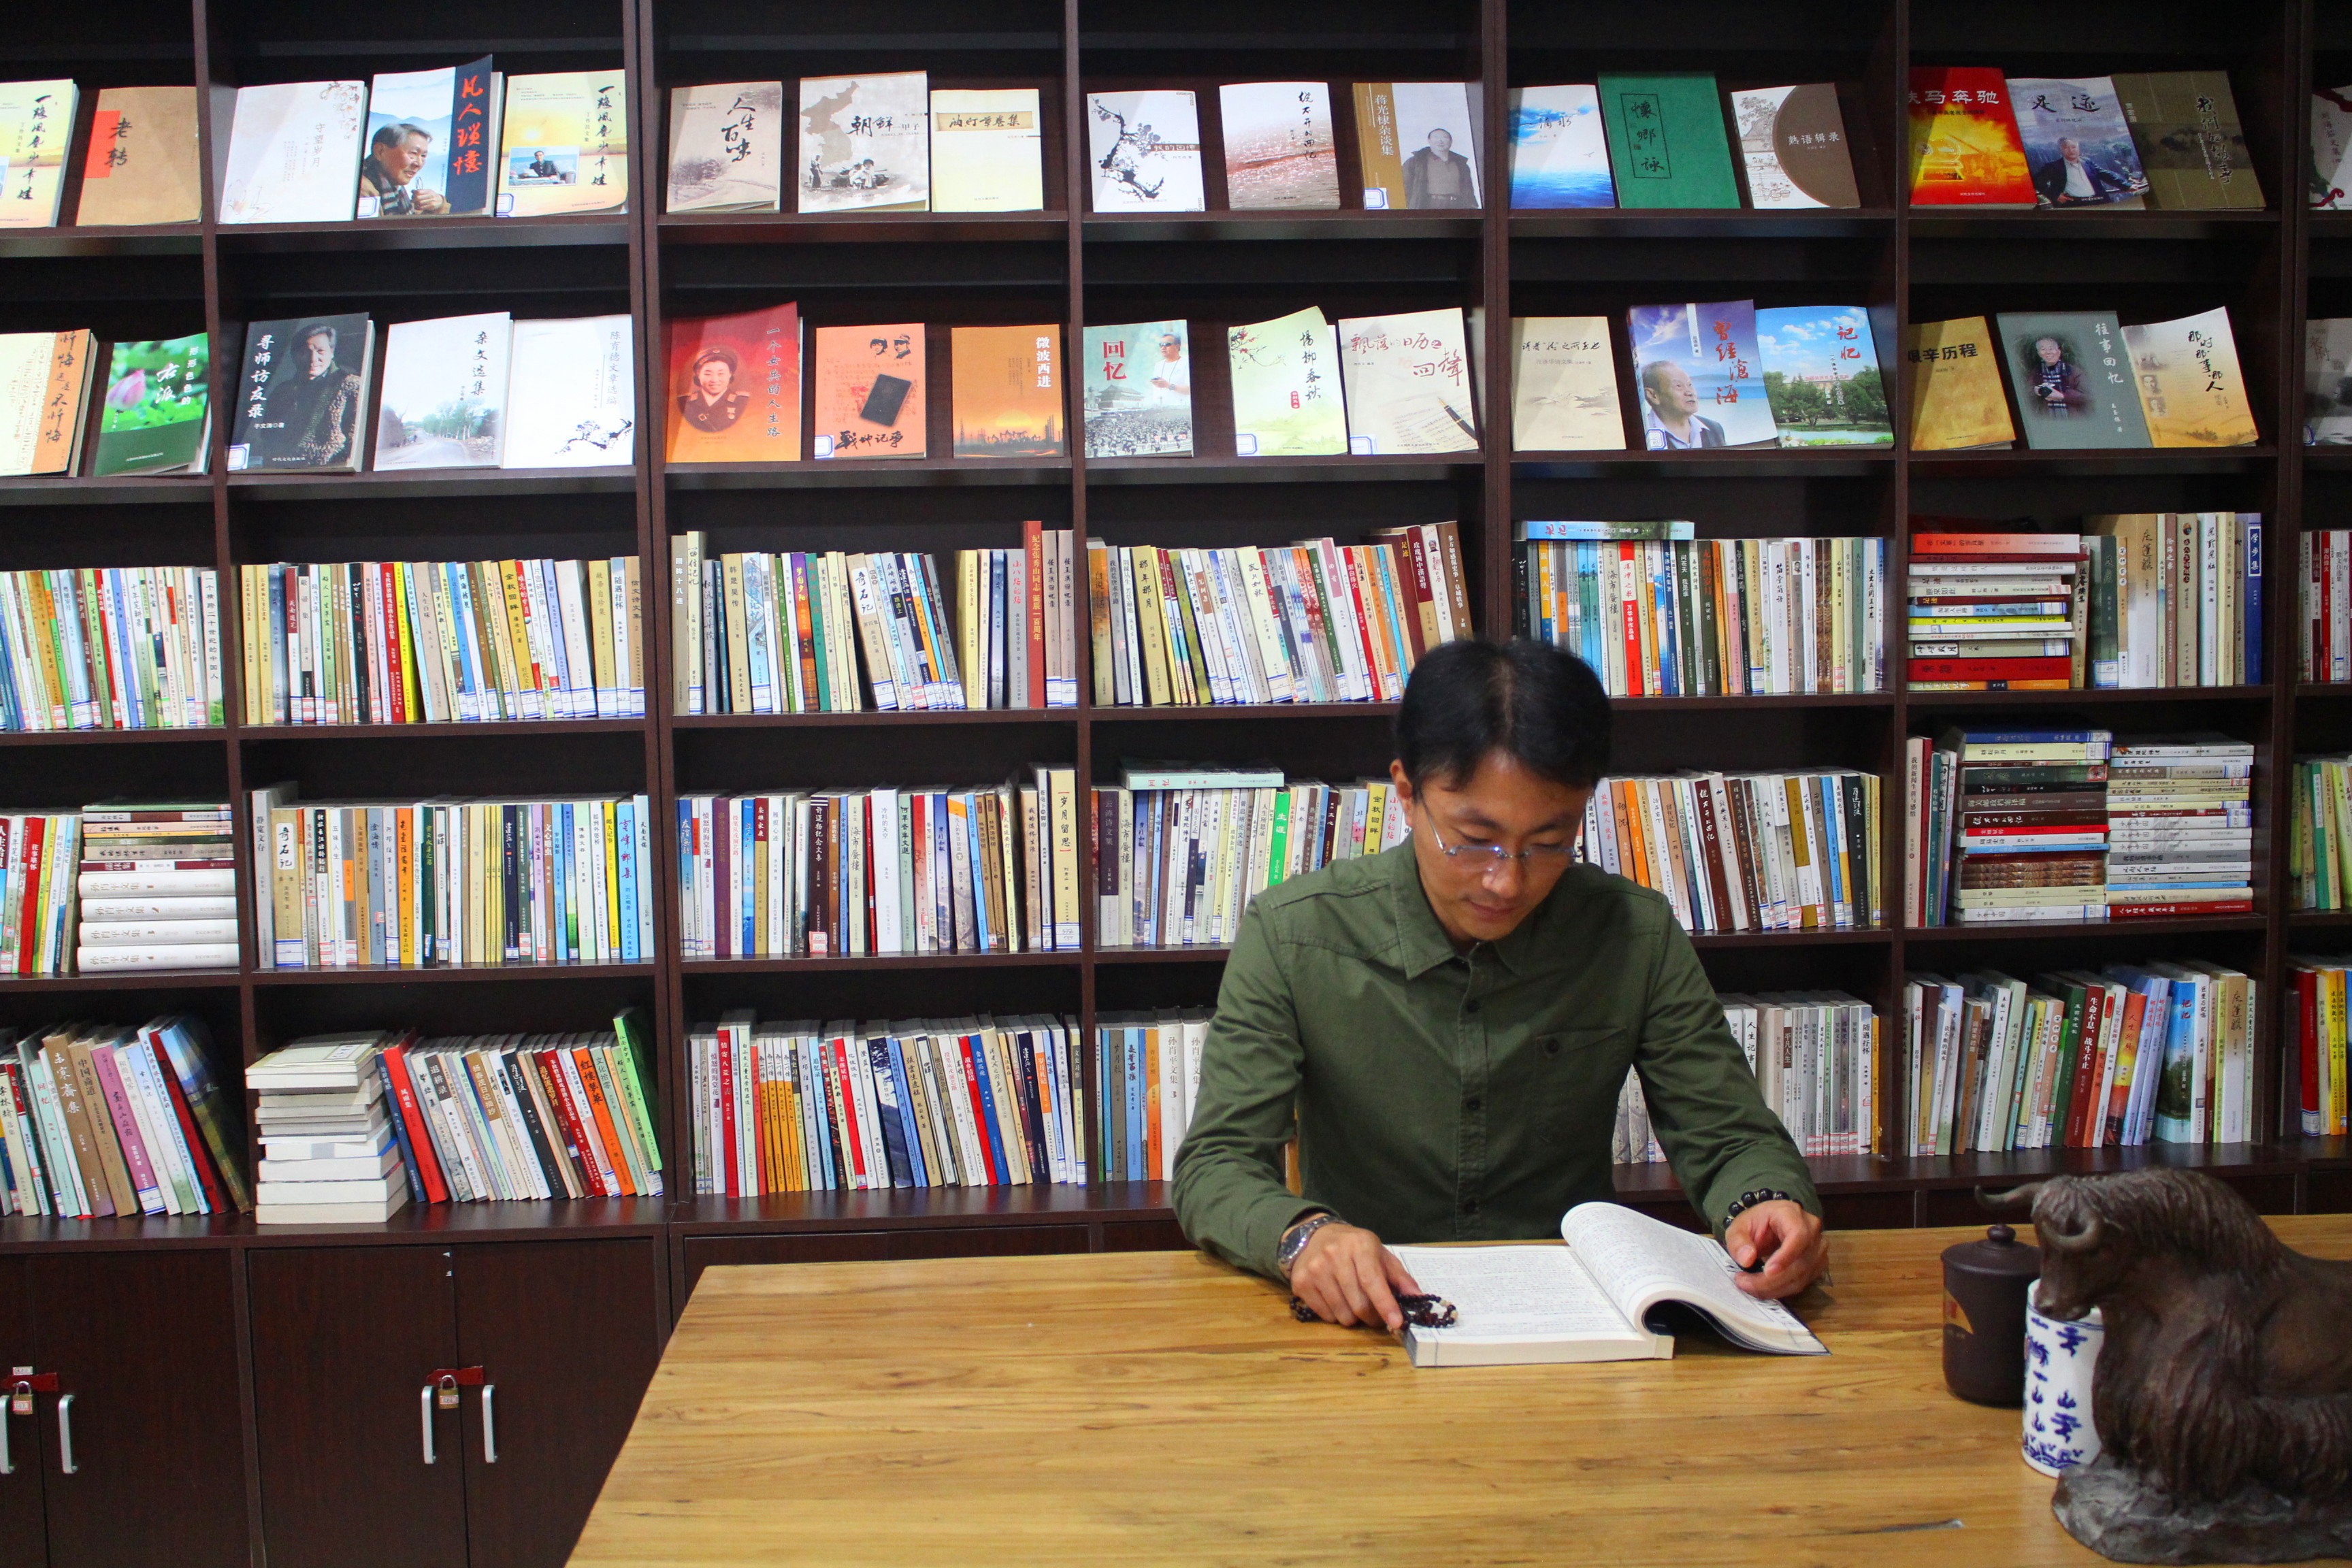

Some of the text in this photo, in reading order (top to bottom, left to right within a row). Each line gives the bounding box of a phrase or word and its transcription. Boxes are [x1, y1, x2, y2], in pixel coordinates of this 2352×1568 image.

[105, 117, 133, 168] 老转
[721, 97, 756, 163] 人生百味
[1035, 336, 1052, 389] 微波西进
[1102, 340, 1128, 382] 回忆
[1836, 325, 1861, 361] 记忆
[2095, 322, 2124, 384] 往事回忆
[180, 346, 199, 406] 形形色色的
[247, 333, 276, 419] 寻师访友录
[766, 327, 782, 438] 一个女兵的人生路
[2250, 532, 2259, 571] 学步集
[504, 572, 520, 611] 金秋回眸
[854, 572, 874, 614] 奇石记
[1059, 795, 1071, 848] 岁月留思
[1369, 796, 1383, 835] 金秋回眸
[278, 826, 293, 868] 奇石记
[2180, 998, 2193, 1020] 记忆
[1167, 1036, 1178, 1085] 孙肖平文集
[1746, 1021, 1757, 1066] 人生记事
[1783, 1032, 1792, 1065] 平凡人生
